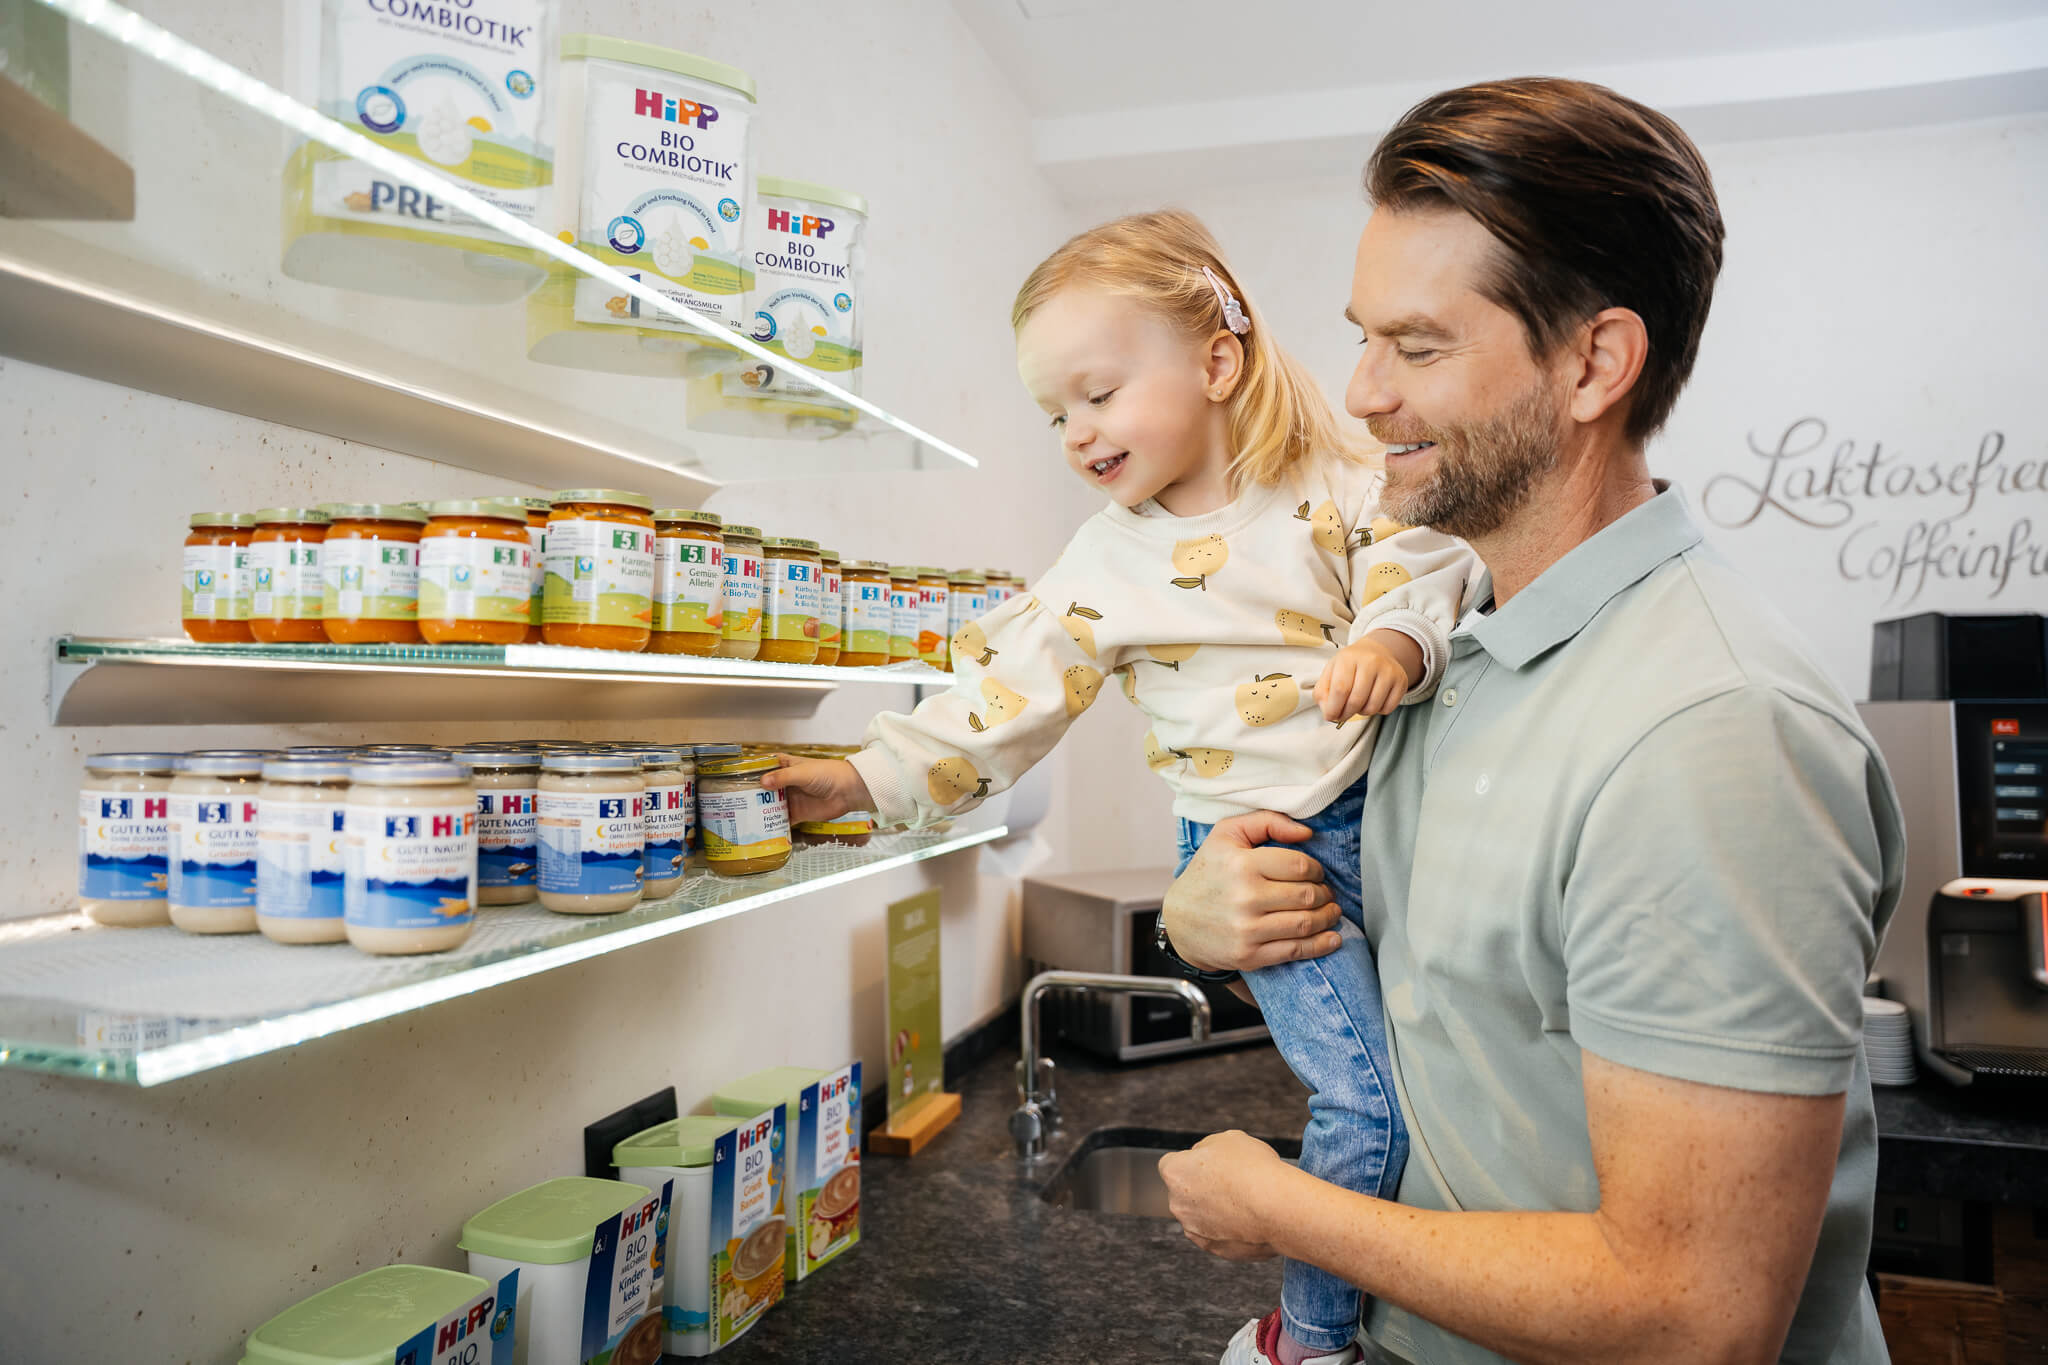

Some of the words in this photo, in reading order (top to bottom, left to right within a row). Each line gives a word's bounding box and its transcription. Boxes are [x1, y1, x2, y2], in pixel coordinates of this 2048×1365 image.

[635, 87, 719, 130] HiPP
[660, 130, 694, 151] BIO
[767, 207, 835, 240] HiPP
[788, 241, 815, 258] BIO
[504, 818, 537, 827] NACHT
[644, 815, 667, 824] GUTE
[821, 1074, 849, 1103] HiPP
[739, 1119, 772, 1153] HiPP
[745, 1150, 764, 1173] BIO
[620, 1197, 660, 1241] HiPP
[625, 1234, 648, 1262] BIO
[622, 1284, 641, 1305] keks
[437, 1296, 495, 1356] HiPP
